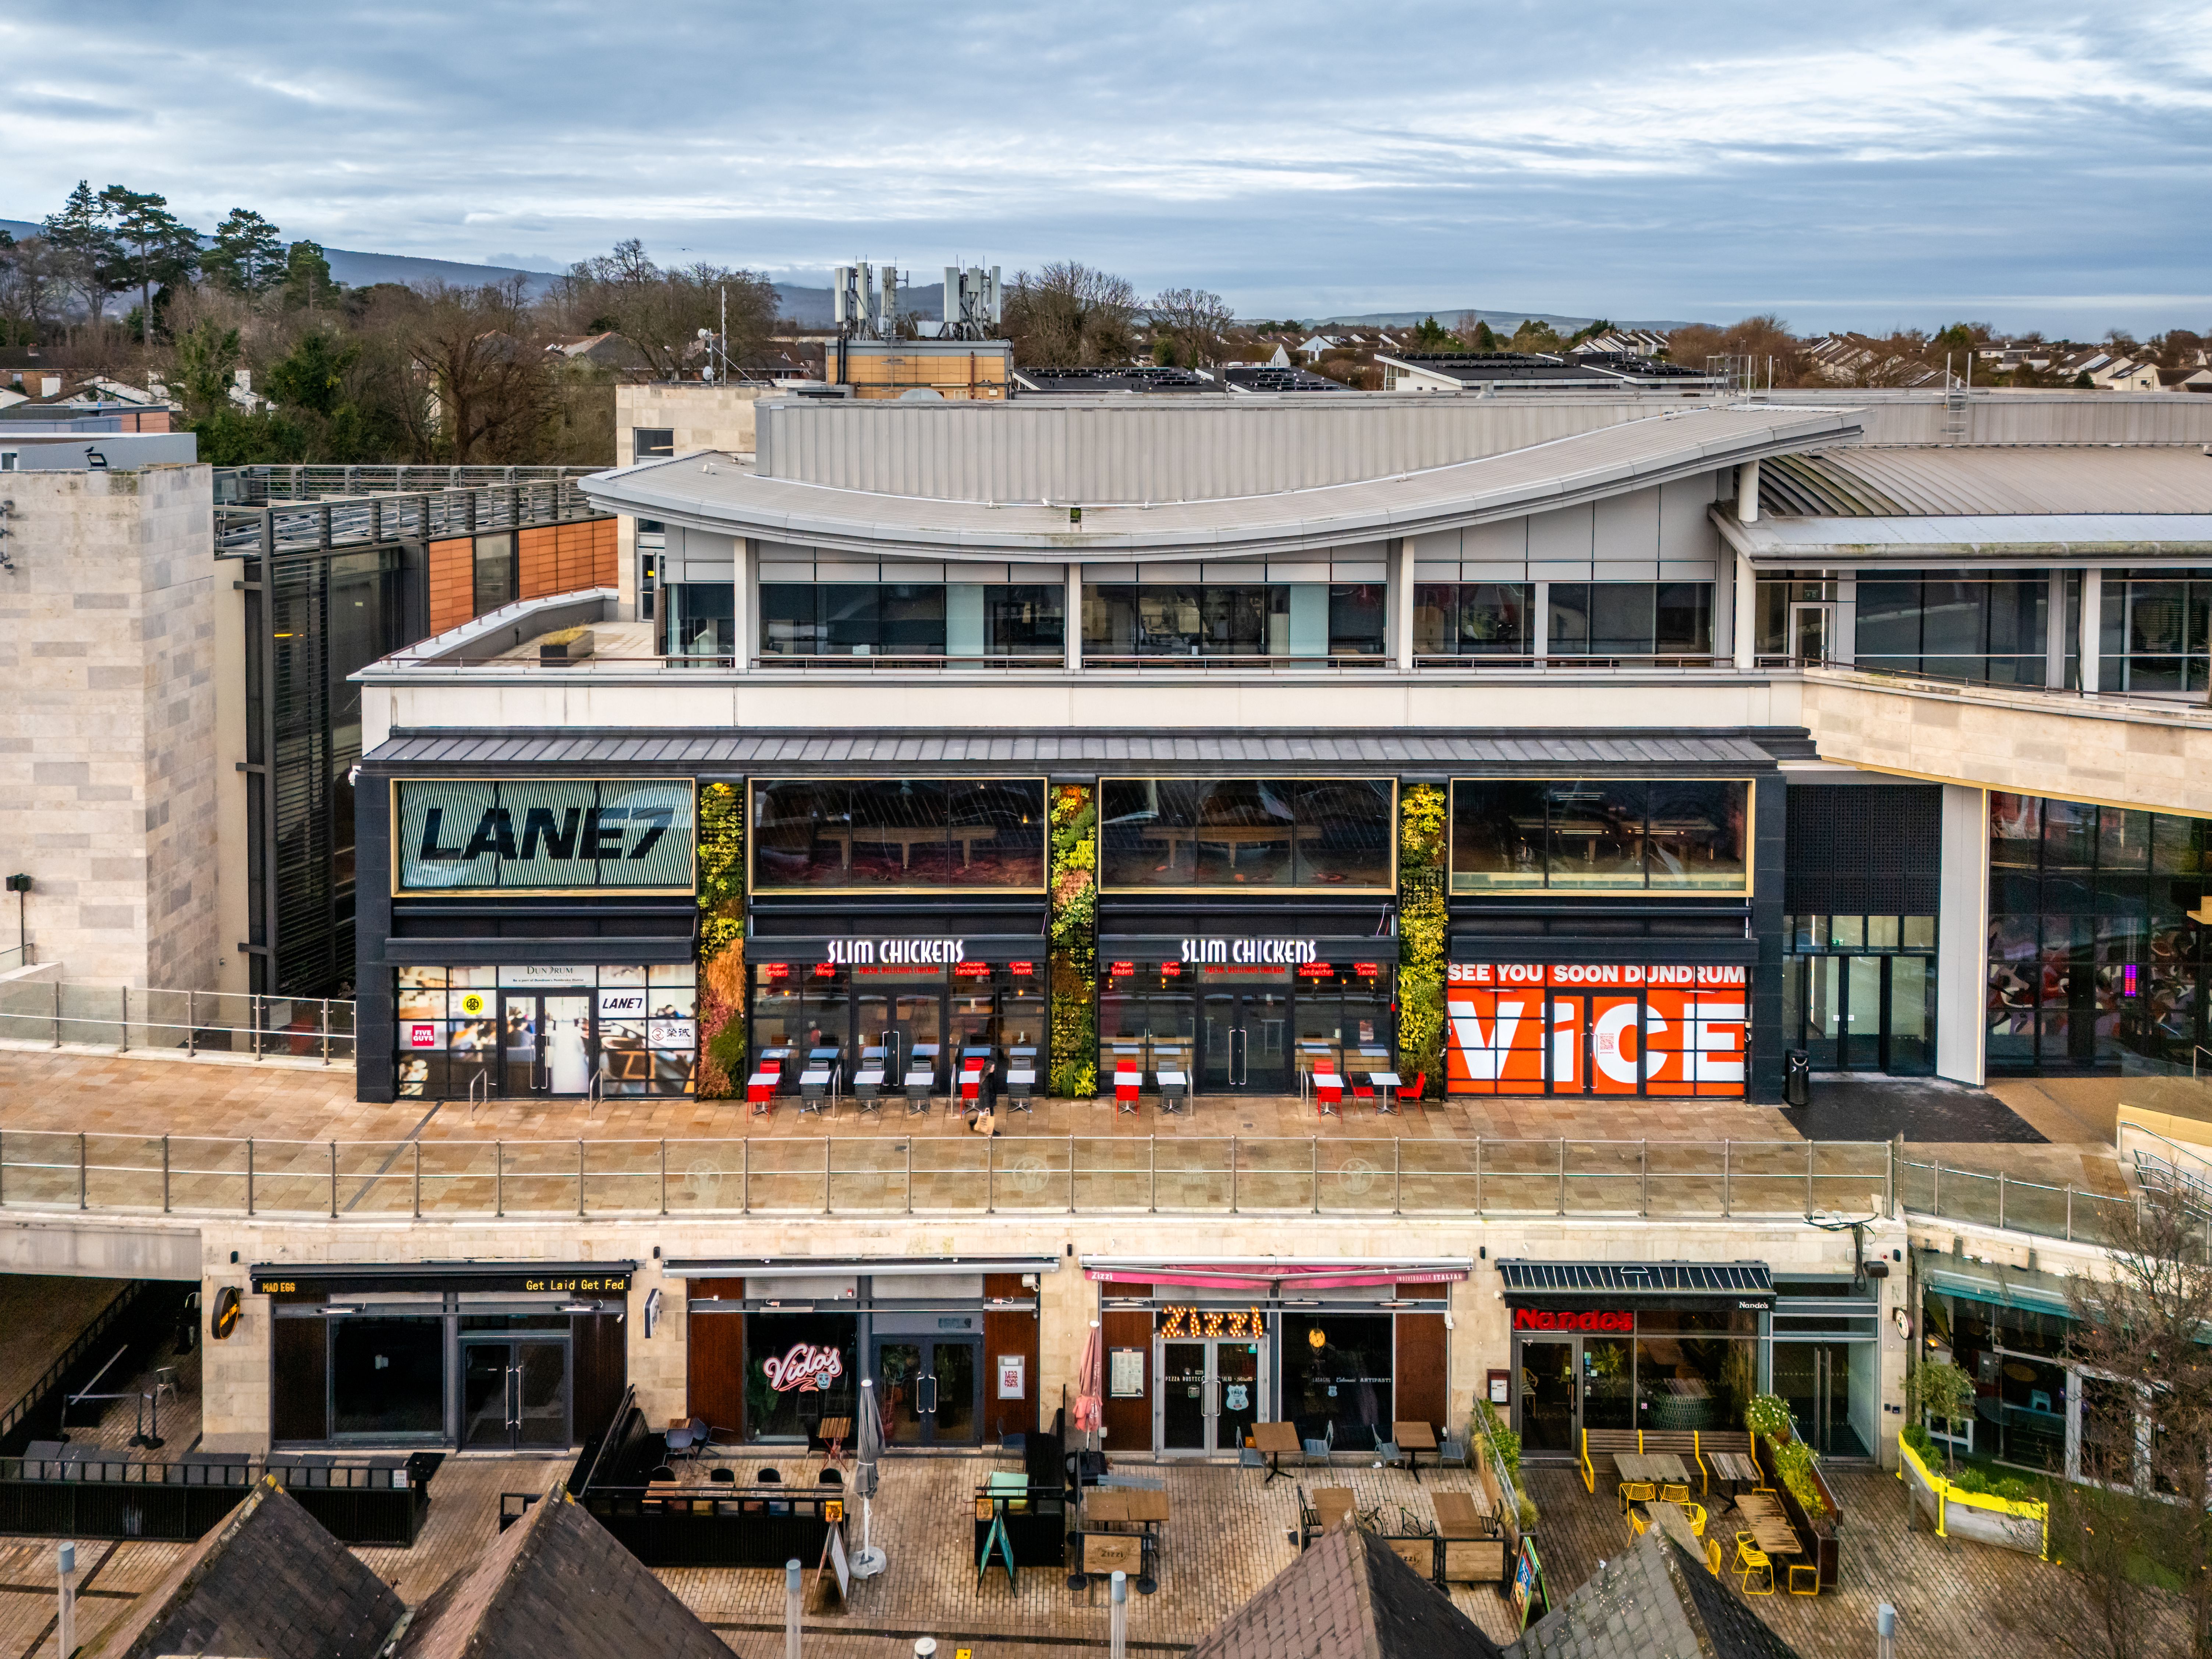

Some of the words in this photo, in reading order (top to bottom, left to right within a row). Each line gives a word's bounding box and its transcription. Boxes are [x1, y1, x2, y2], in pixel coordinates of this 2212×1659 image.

[420, 808, 674, 860] LANE7
[828, 940, 873, 964] SLIM
[880, 939, 964, 964] CHICKENS
[1181, 939, 1227, 963] SLIM
[1233, 939, 1316, 963] CHICKENS
[956, 967, 990, 975] Sandwiches
[1013, 967, 1032, 975] Sauces
[1112, 967, 1134, 975] Tenders
[1162, 967, 1180, 976] Wings
[1299, 968, 1334, 976] Sandwiches
[1448, 964, 1490, 981] SEE
[1497, 965, 1543, 981] YOU
[1554, 965, 1618, 982] SOON
[1625, 966, 1745, 983] DUNDRUM
[602, 998, 642, 1009] LANE7
[1091, 1272, 1113, 1280] Zizzi
[262, 1283, 278, 1292] MAD
[280, 1283, 295, 1292] EGG
[527, 1280, 544, 1290] Get
[551, 1280, 575, 1290] Laid
[581, 1280, 599, 1290] Get
[1161, 1306, 1263, 1339] Zizzi
[1514, 1309, 1634, 1331] Nando's
[764, 1344, 843, 1390] Vida's
